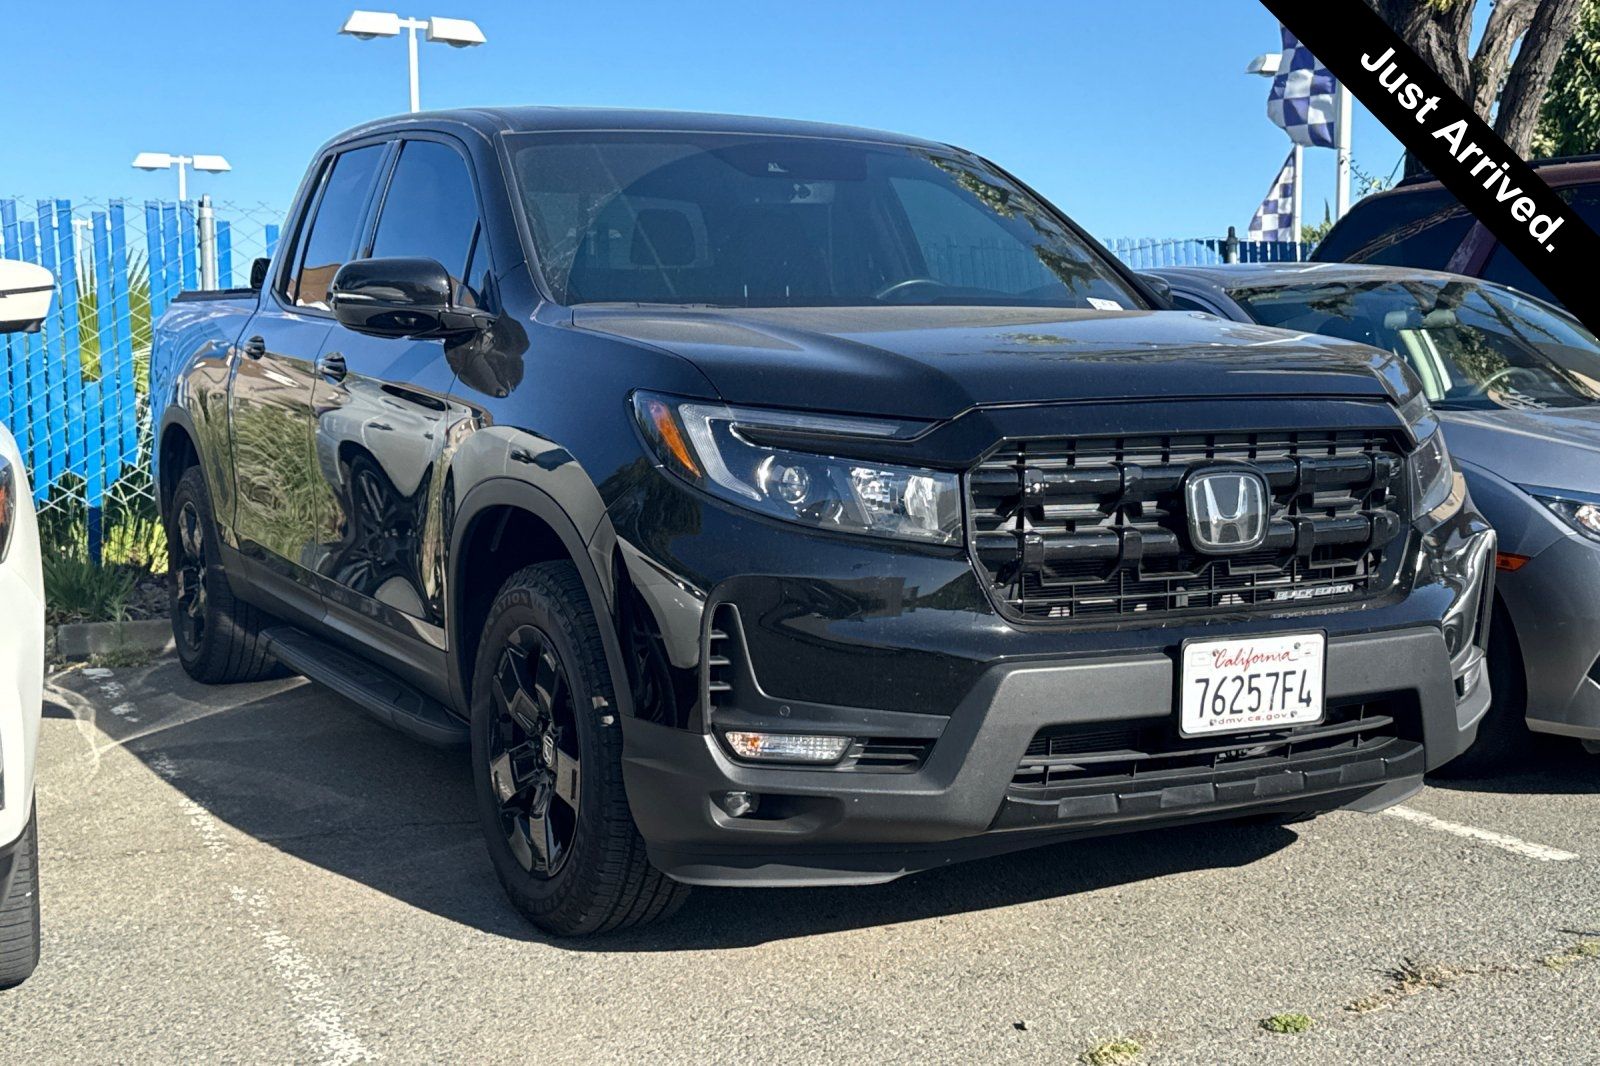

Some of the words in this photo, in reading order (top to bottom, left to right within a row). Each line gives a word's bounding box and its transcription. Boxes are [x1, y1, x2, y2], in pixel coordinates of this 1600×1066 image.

[1275, 588, 1315, 601] BLACK
[1314, 583, 1354, 597] EDITION
[1213, 648, 1299, 673] California
[1194, 668, 1313, 719] 76257F4
[1217, 712, 1288, 726] dmv.ca.gov
